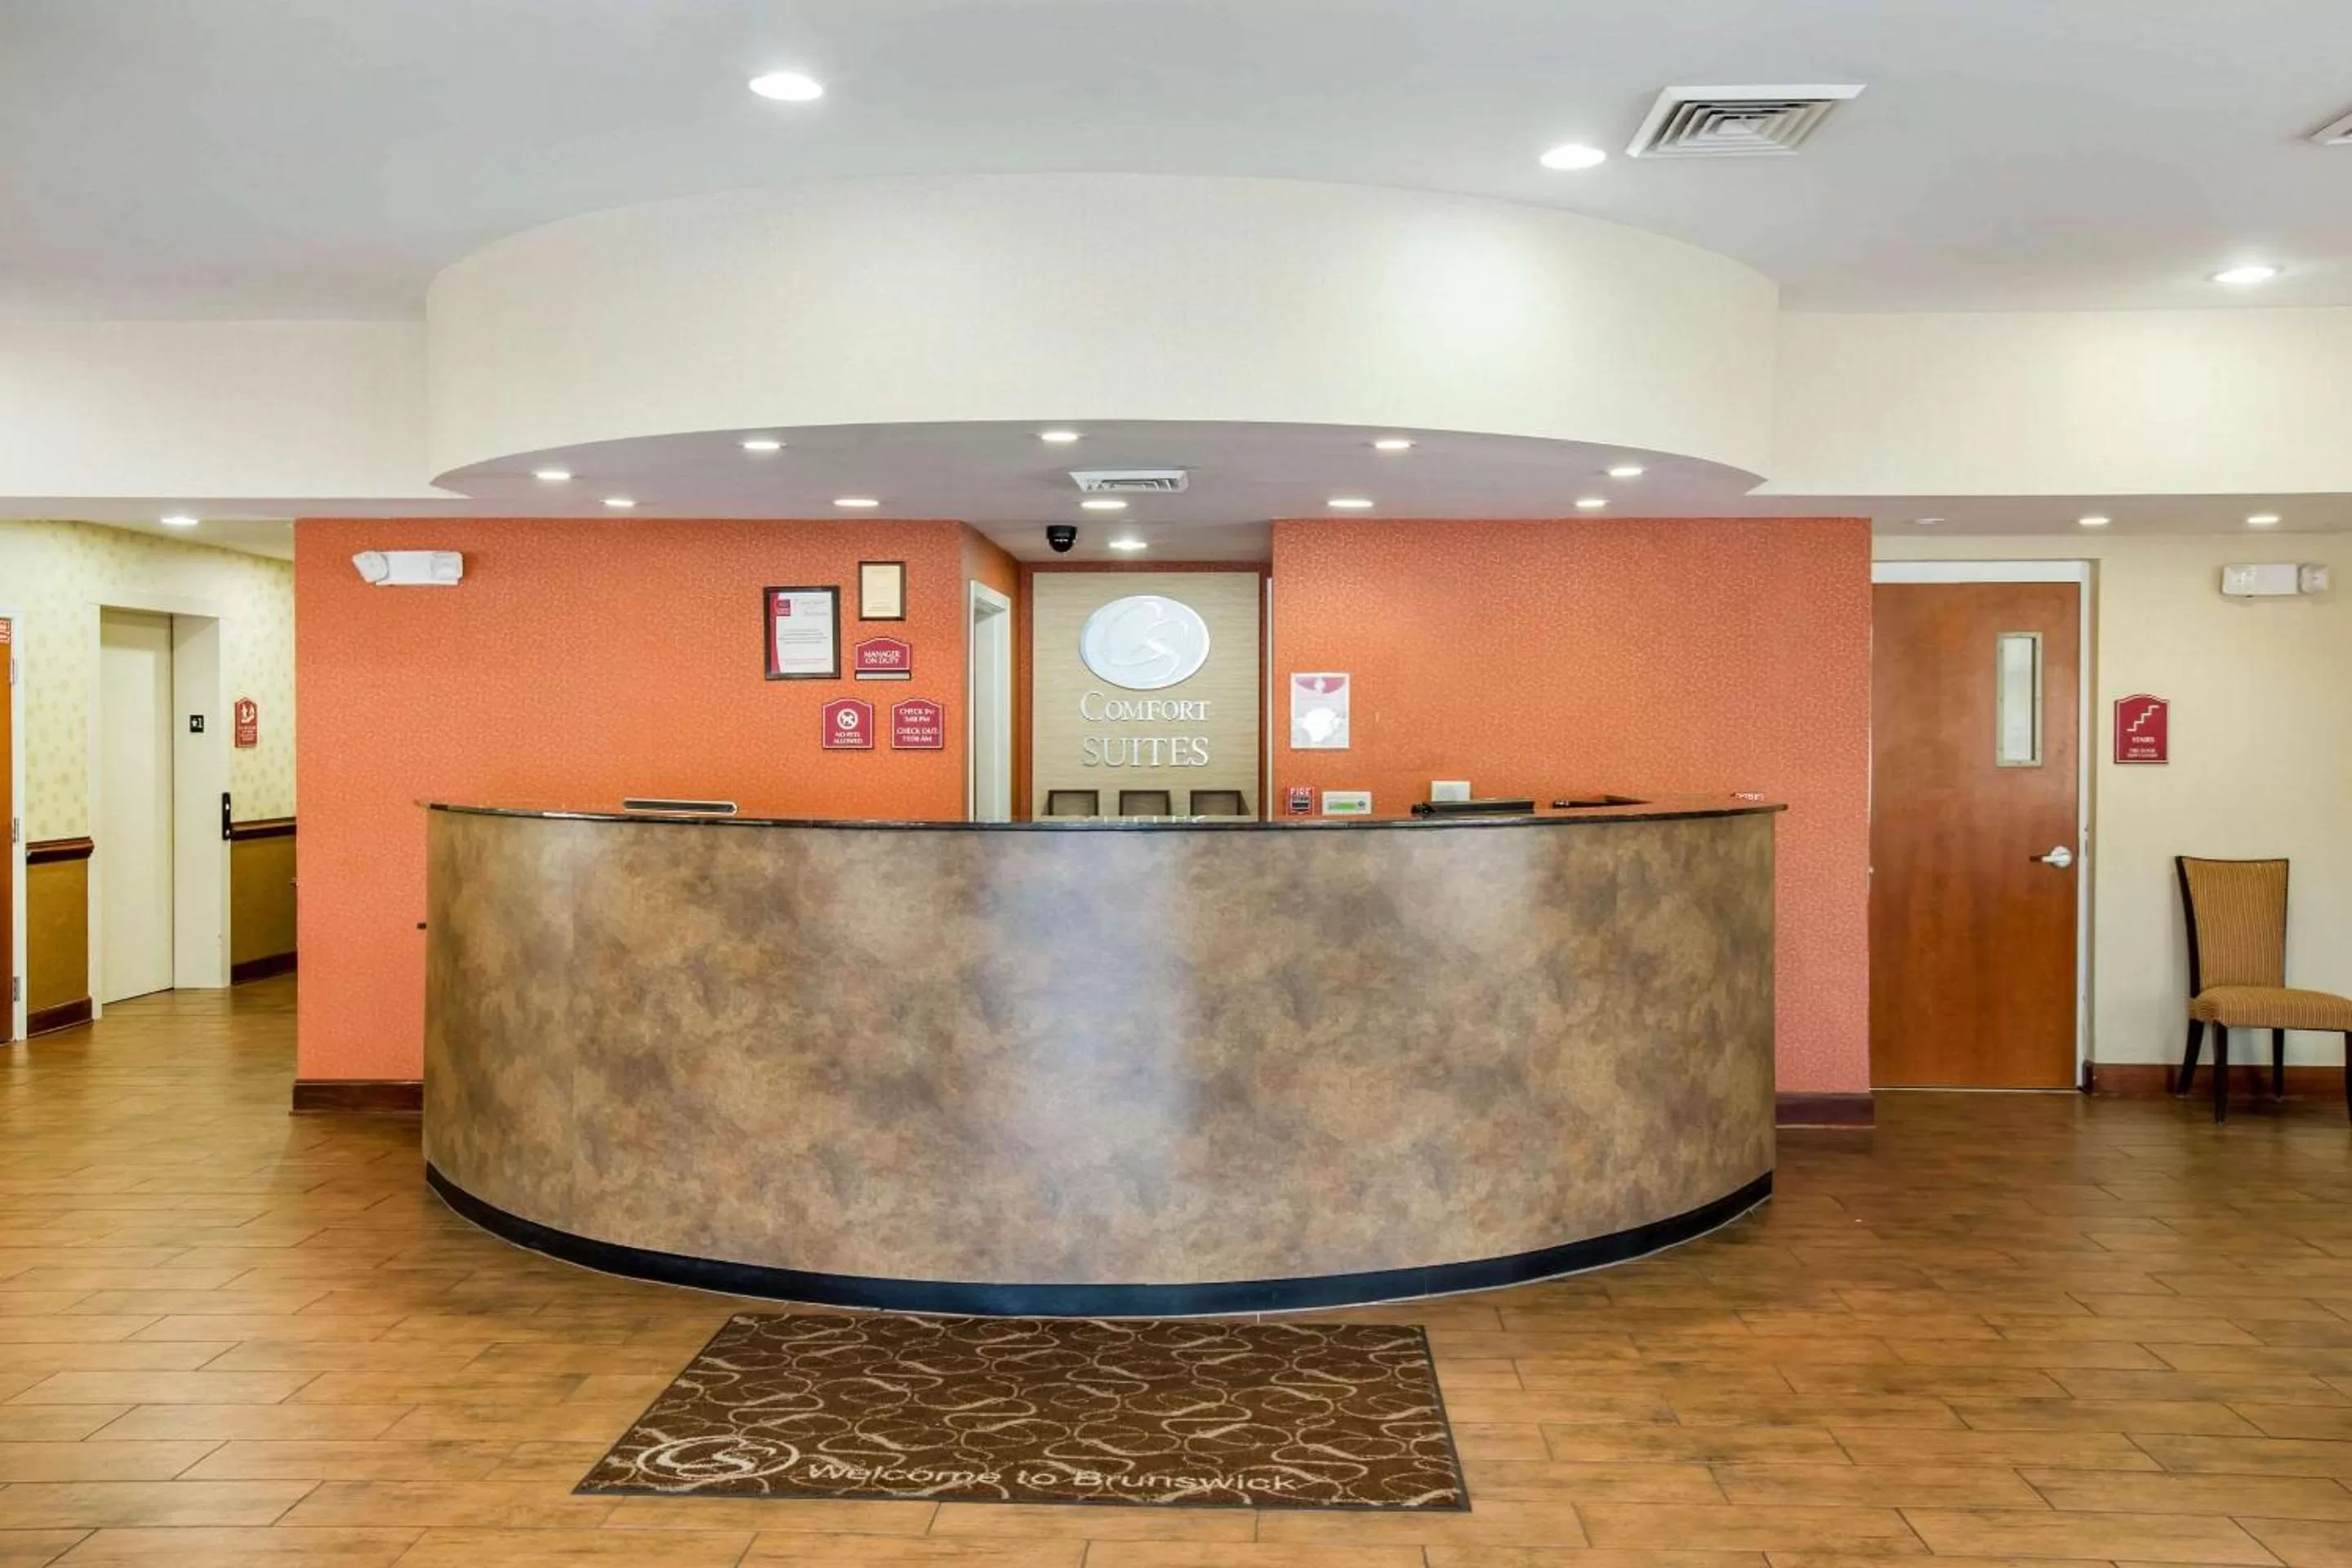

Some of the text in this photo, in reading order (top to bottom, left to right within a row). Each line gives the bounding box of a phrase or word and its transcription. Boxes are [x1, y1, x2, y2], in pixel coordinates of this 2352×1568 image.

[863, 650, 901, 658] MANAGER
[897, 727, 920, 735] CHECK
[1082, 737, 1209, 767] SUITES
[1290, 786, 1312, 796] FIRE
[808, 1463, 1296, 1490] Welcome to Brunswick
